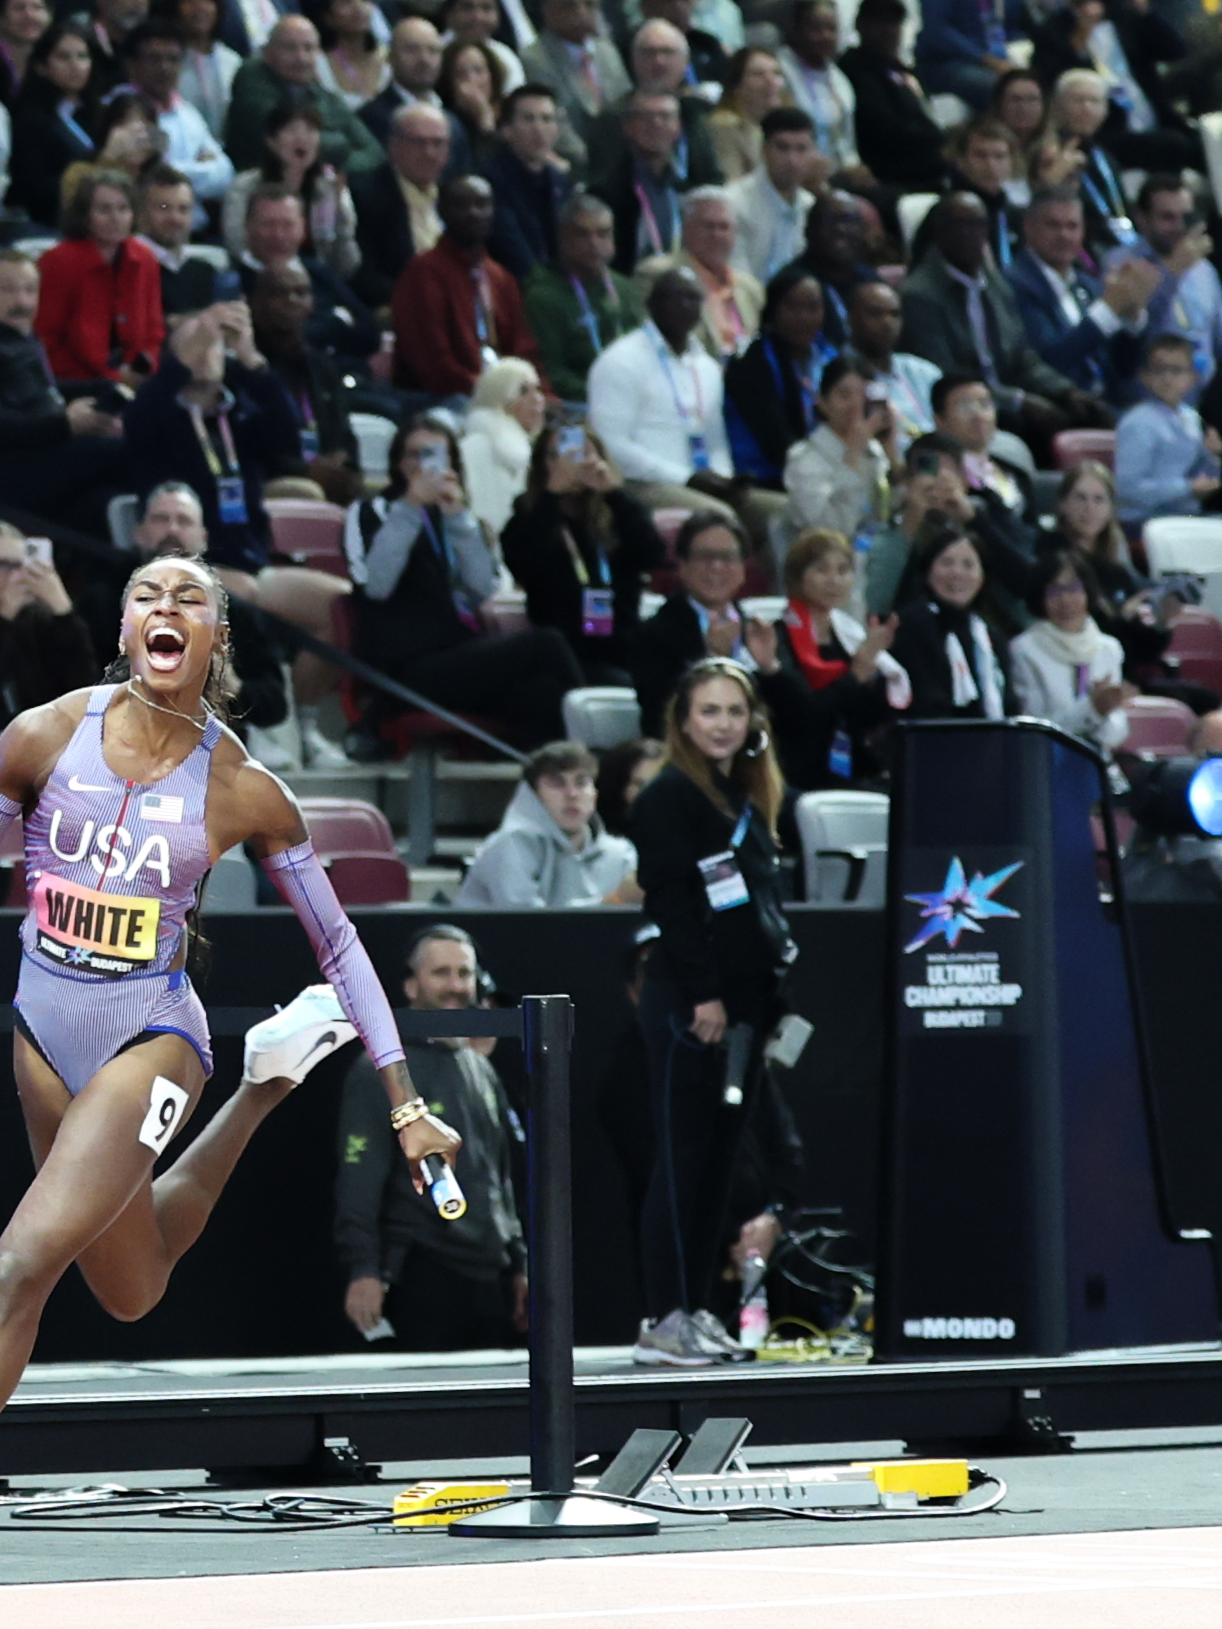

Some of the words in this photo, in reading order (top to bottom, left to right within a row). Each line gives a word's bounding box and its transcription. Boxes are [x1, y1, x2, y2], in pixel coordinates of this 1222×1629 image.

[49, 809, 171, 889] USA
[45, 887, 146, 949] WHITE
[90, 957, 134, 973] BUDAPEST
[926, 963, 1000, 985] ULTIMATE
[904, 984, 1022, 1008] CHAMPIONSHIP
[923, 1010, 986, 1028] BUDAPEST
[154, 1097, 177, 1142] 9
[922, 1317, 1015, 1340] MONDO
